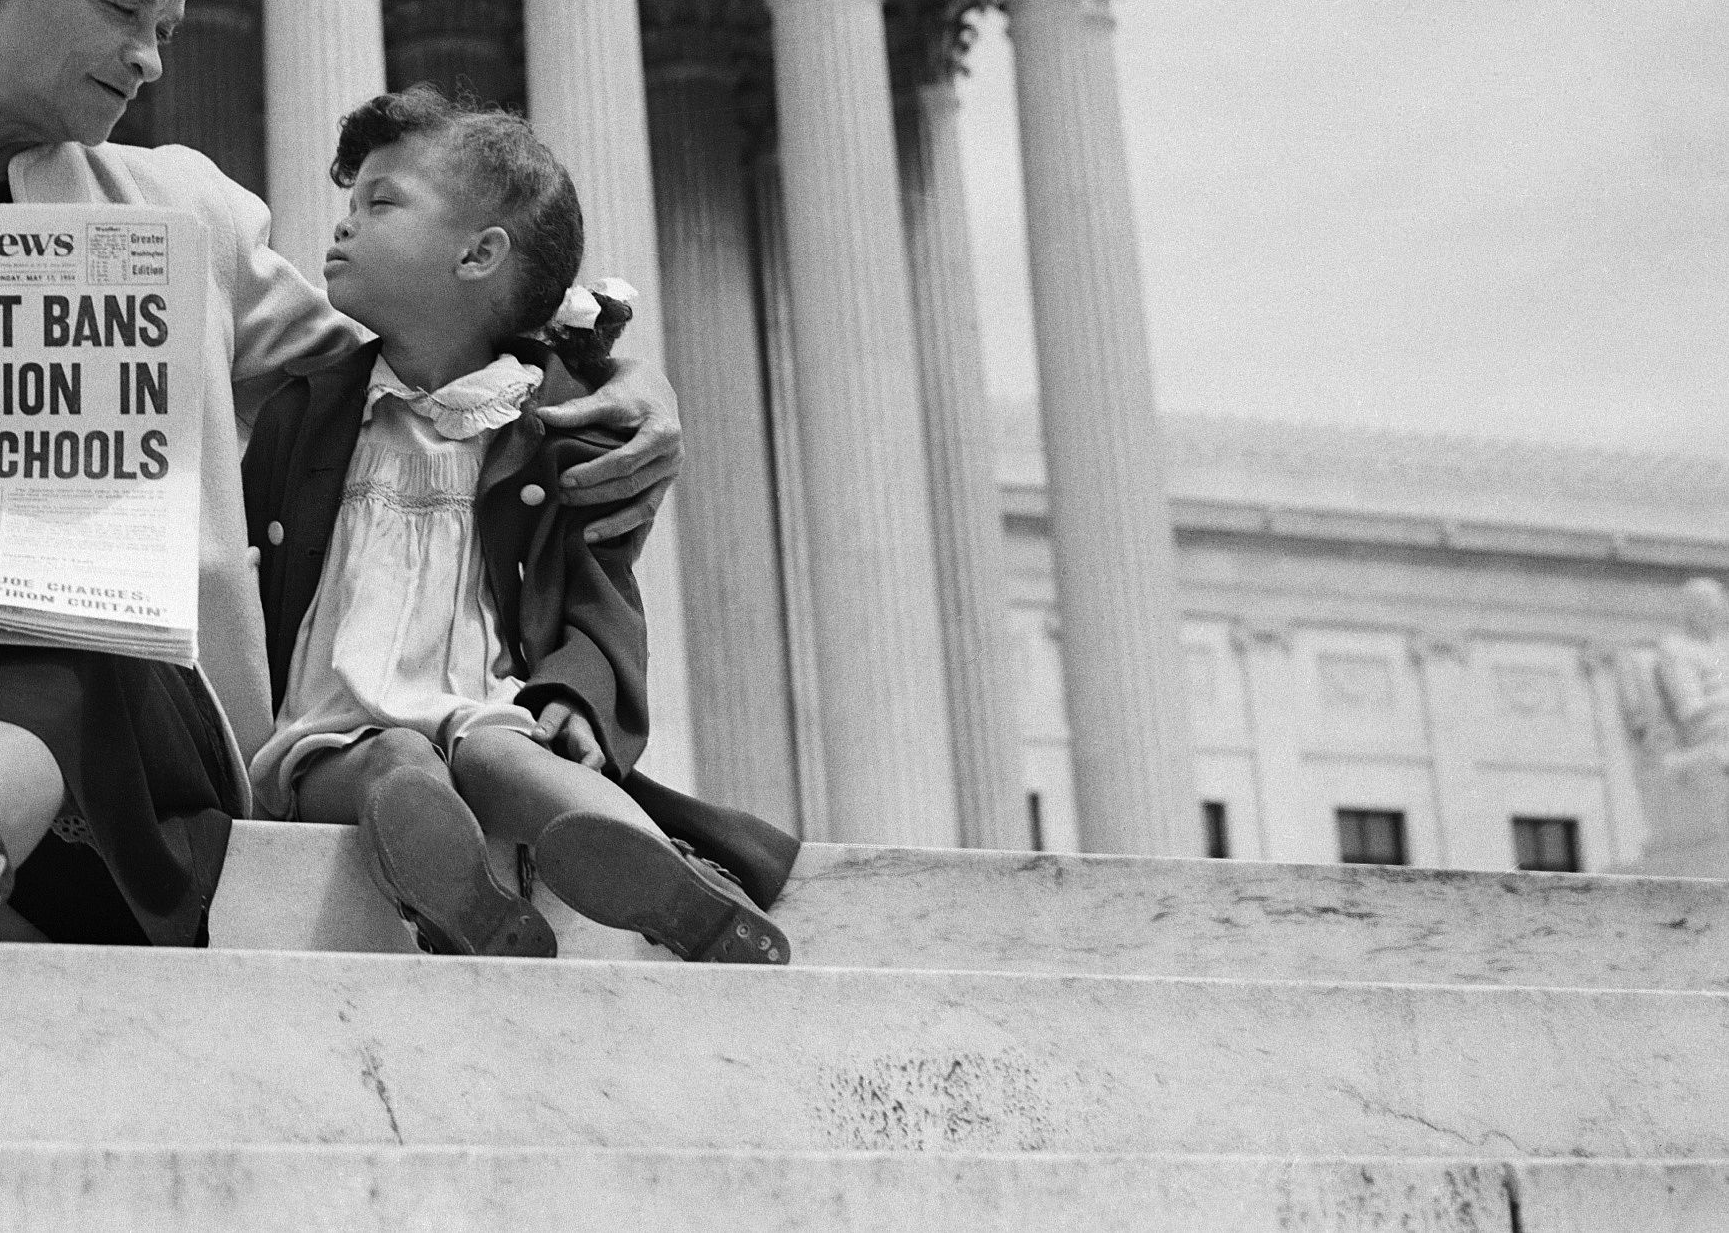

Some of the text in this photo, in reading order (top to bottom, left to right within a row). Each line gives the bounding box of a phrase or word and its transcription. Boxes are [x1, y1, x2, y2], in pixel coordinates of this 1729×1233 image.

[130, 233, 164, 244] Greater
[132, 264, 164, 275] Edition
[44, 295, 167, 347] BANS
[121, 363, 167, 414] IN
[2, 576, 34, 589] JOE
